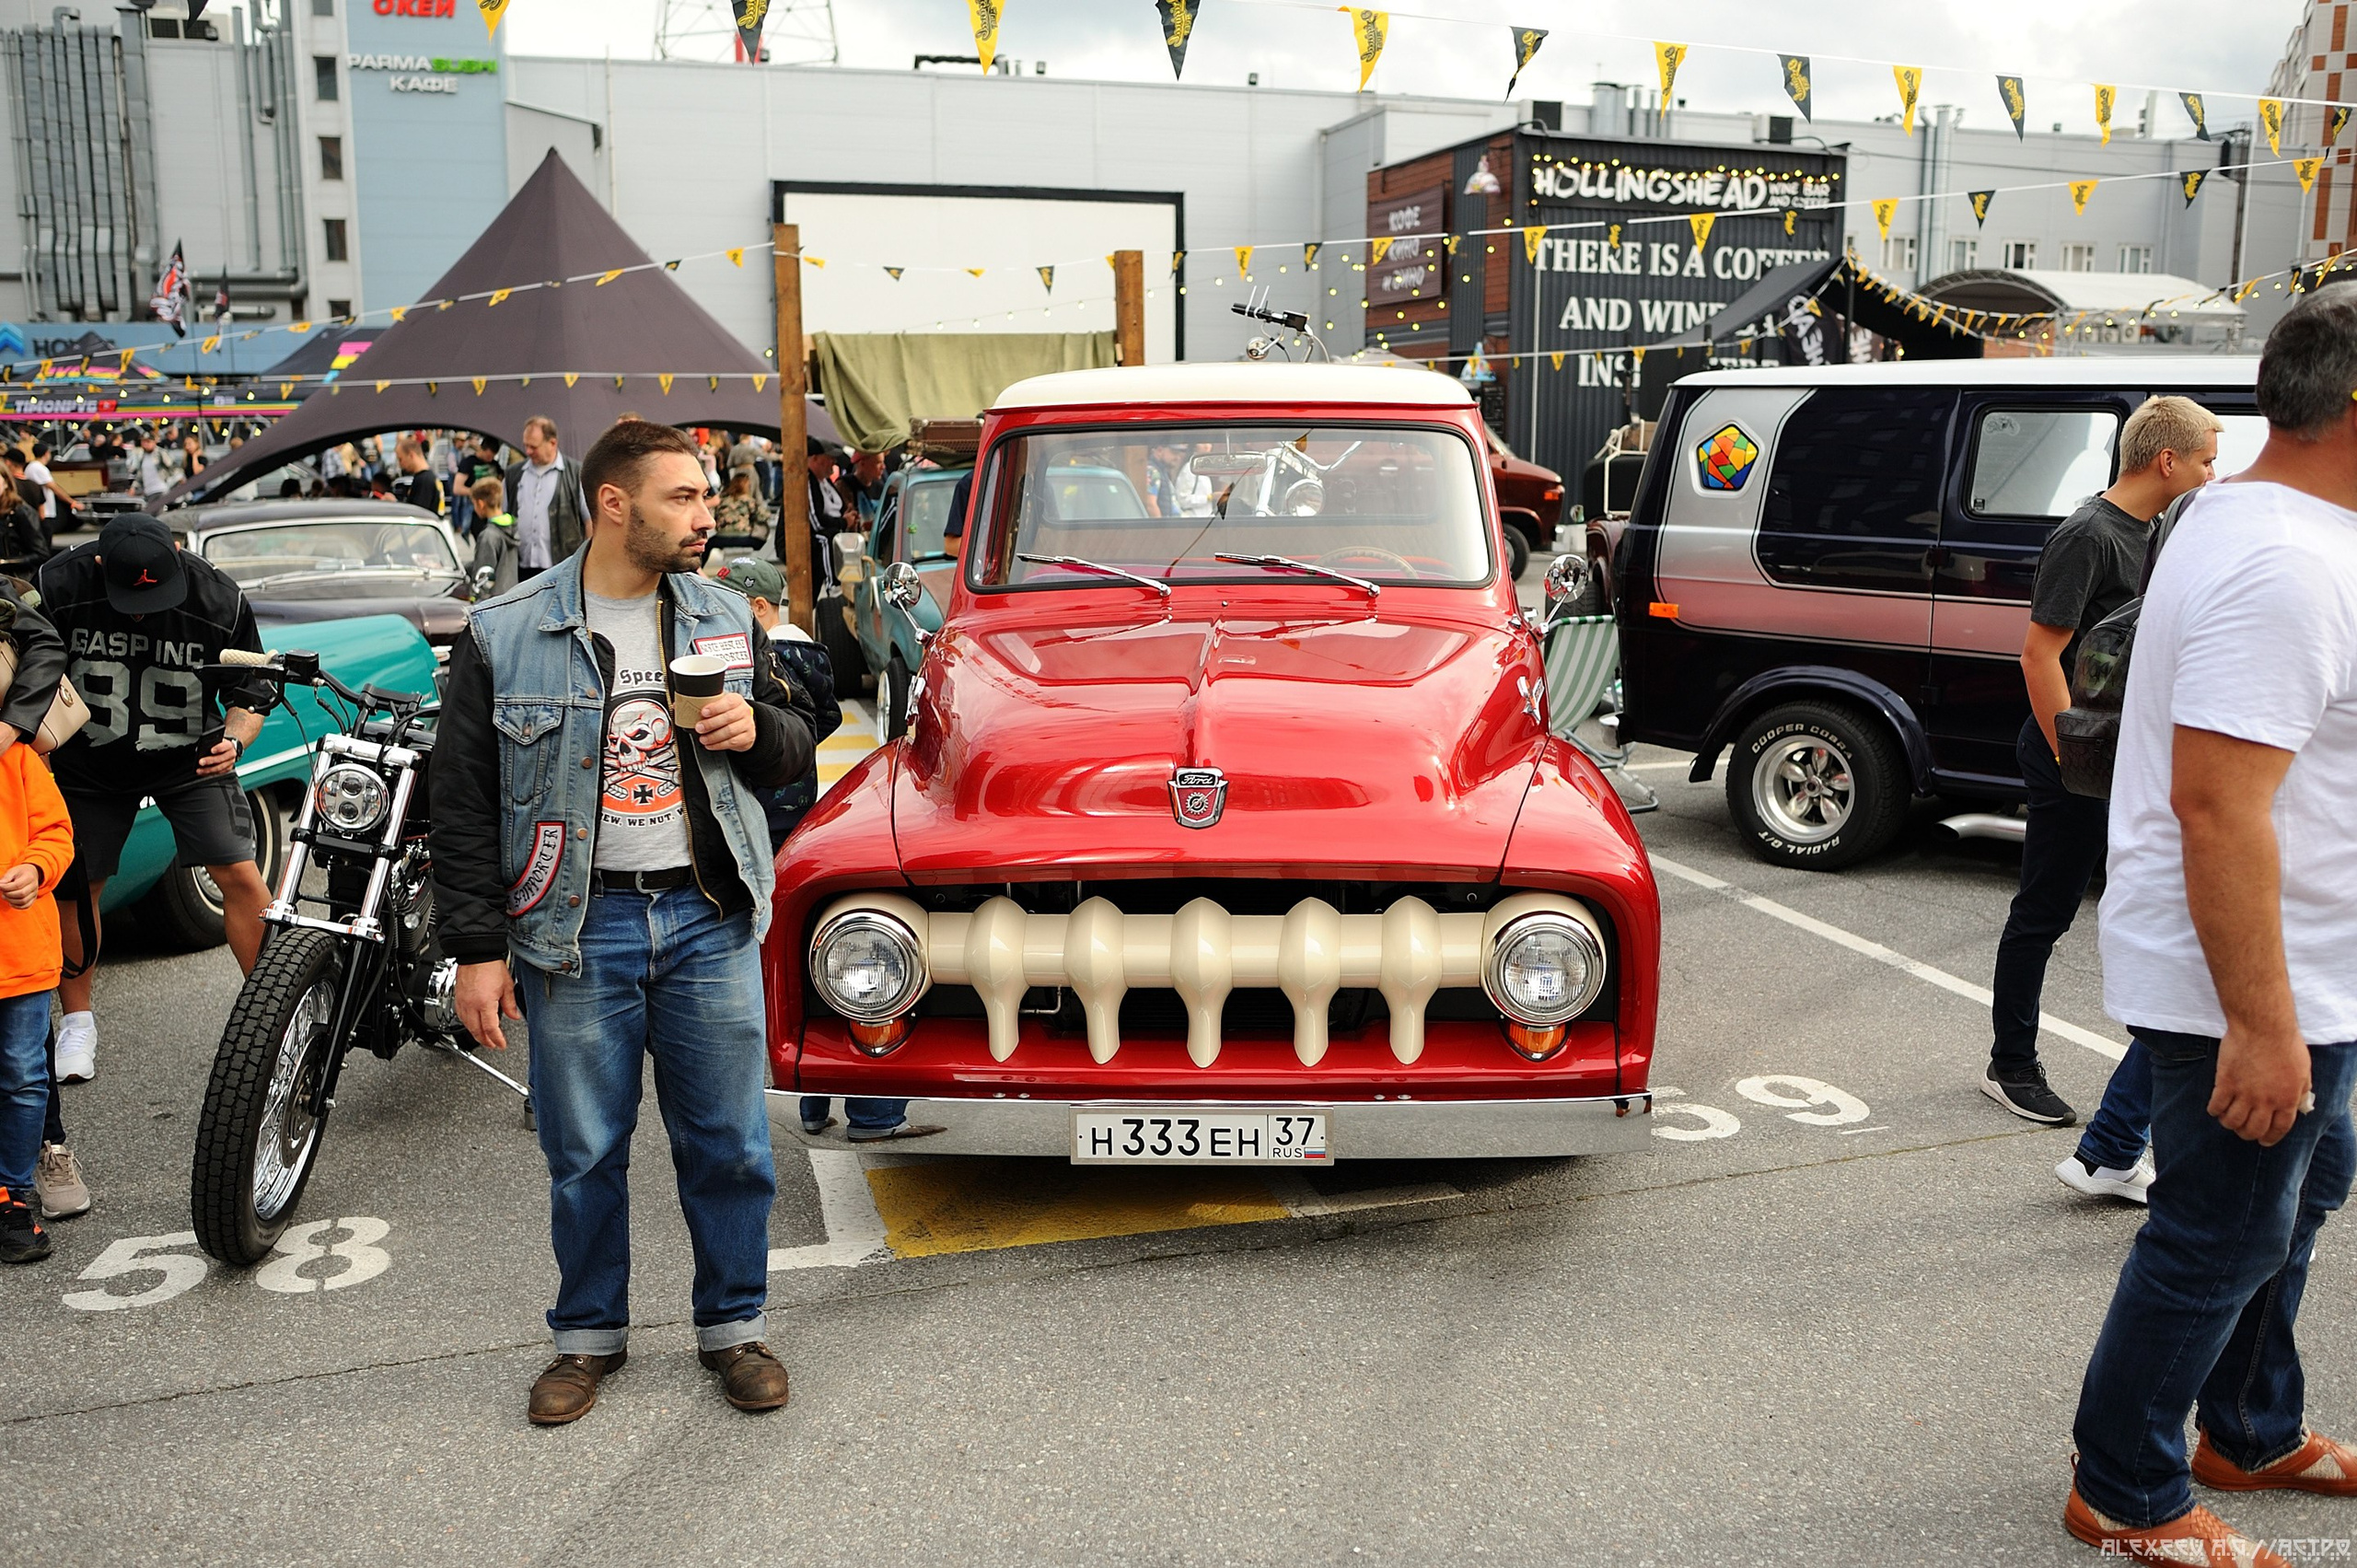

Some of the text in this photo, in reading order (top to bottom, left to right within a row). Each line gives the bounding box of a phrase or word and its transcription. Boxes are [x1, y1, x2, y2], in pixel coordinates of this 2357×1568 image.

[1536, 167, 1767, 210] HOLLINGSHEAD
[1535, 238, 1642, 275] THERE
[1649, 243, 1679, 276] IS
[1682, 244, 1706, 278] A
[1559, 296, 1632, 331] AND
[70, 628, 204, 670] GASP INC
[620, 669, 666, 686] Spee
[71, 657, 204, 751] 89
[1751, 723, 1853, 760] COOPER COBRA
[1180, 774, 1213, 784] Ford
[627, 818, 645, 827] WE
[649, 812, 675, 825] NUT.
[1758, 830, 1840, 854] RADIAL G/T
[1275, 1117, 1315, 1145] 37
[1272, 1148, 1303, 1158] RUS
